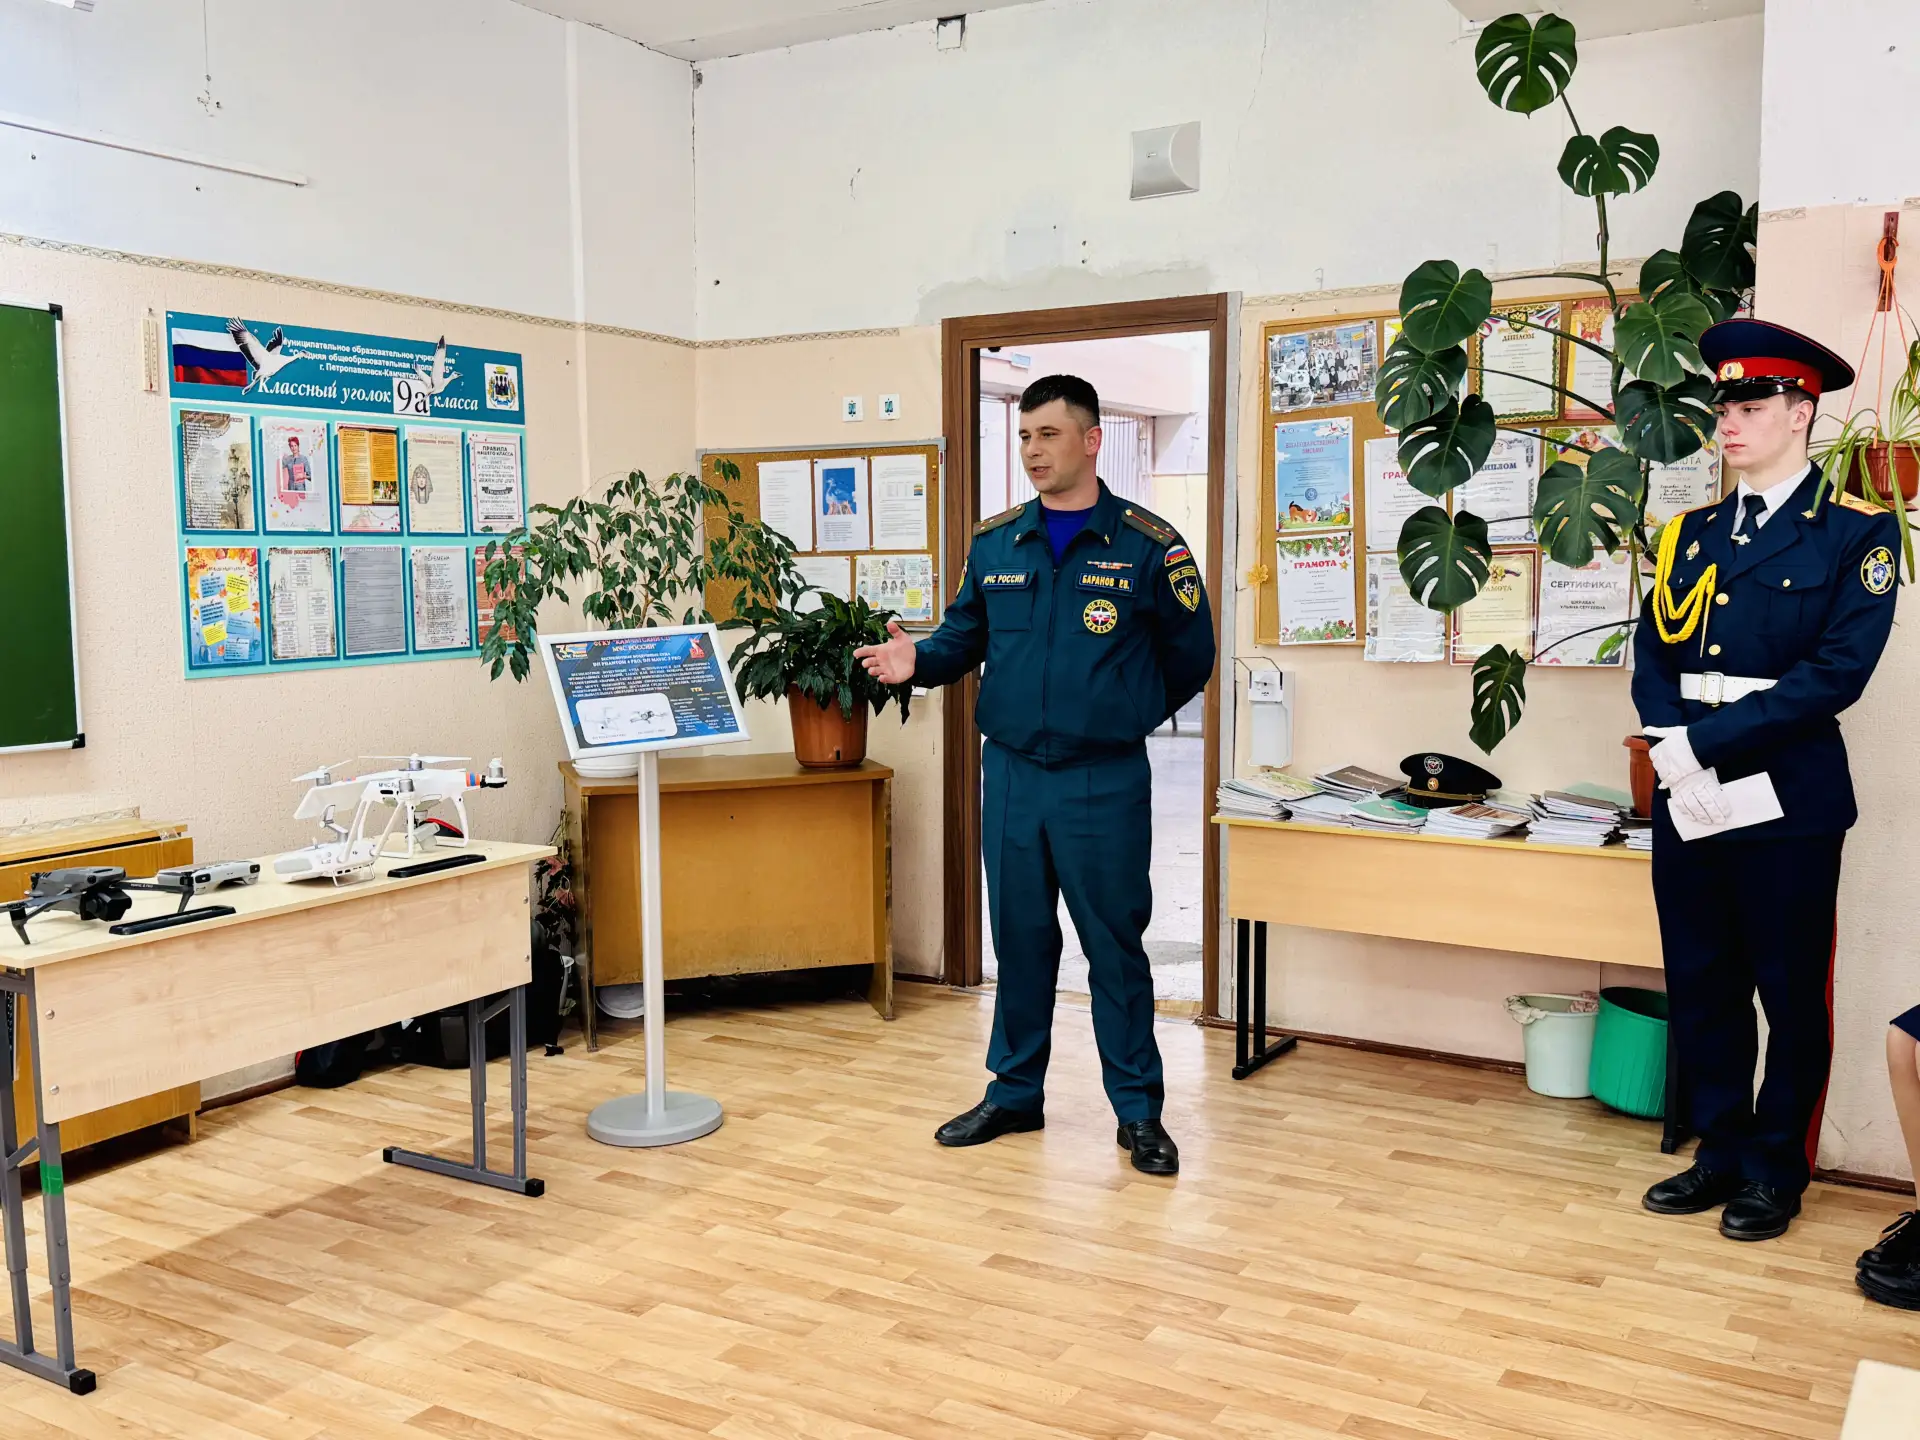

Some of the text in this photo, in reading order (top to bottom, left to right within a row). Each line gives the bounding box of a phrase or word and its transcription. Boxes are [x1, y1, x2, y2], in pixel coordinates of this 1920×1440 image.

[352, 345, 415, 360] образовательное
[328, 353, 411, 369] общеобразовательная
[258, 375, 479, 414] Классный уголок 9а класса
[1294, 559, 1337, 569] ГРАМОТА
[983, 574, 1026, 585] МЧС РОССИИ
[1082, 574, 1115, 587] БАРАНОВ
[1550, 580, 1619, 589] СЕРТИФИКАТ
